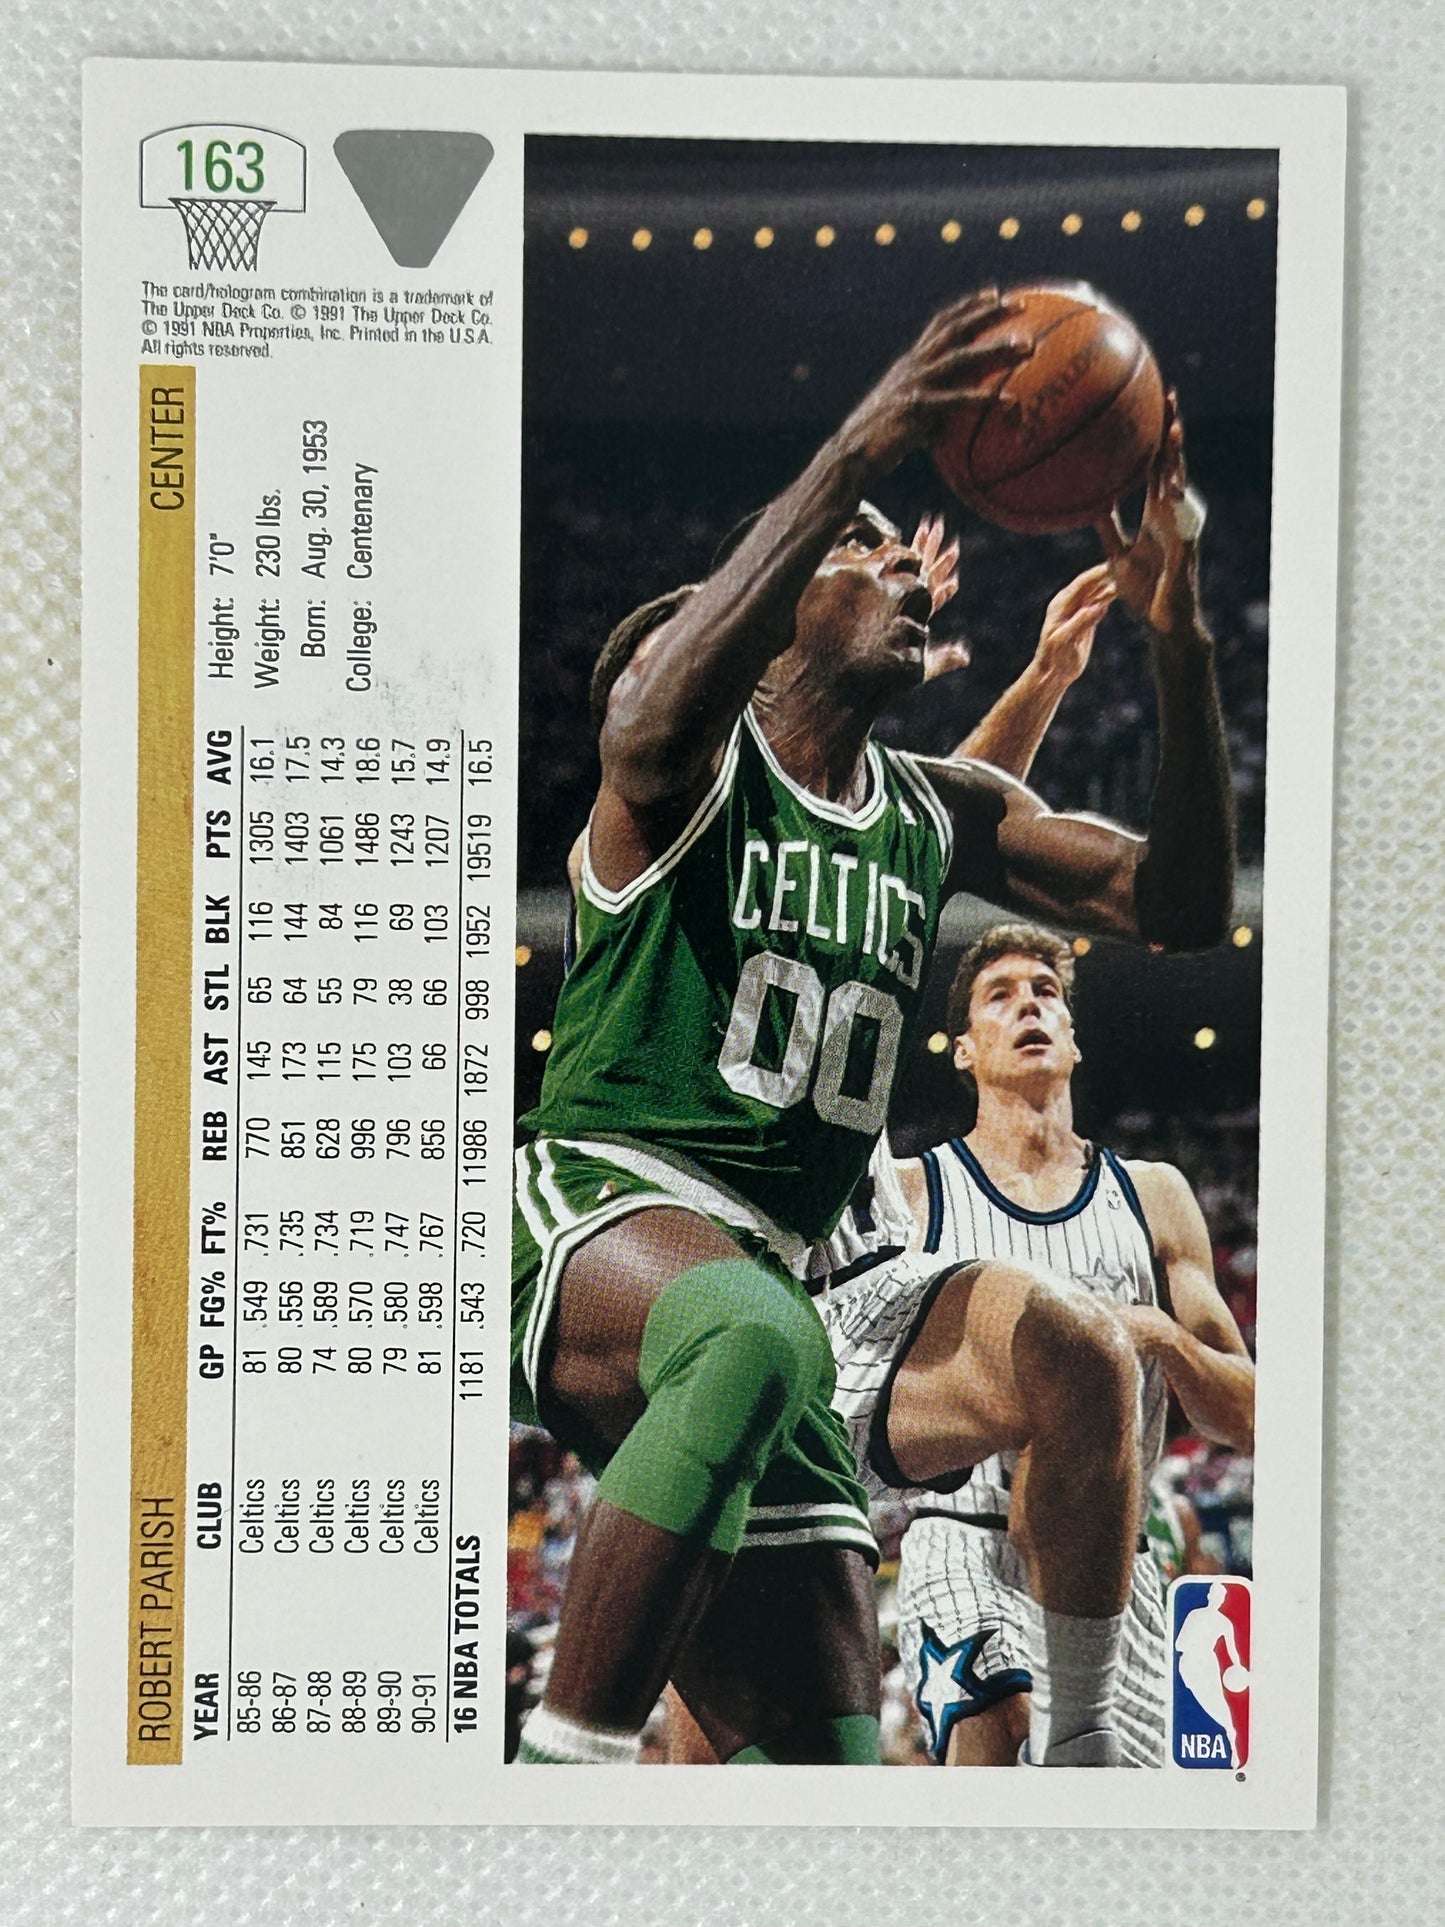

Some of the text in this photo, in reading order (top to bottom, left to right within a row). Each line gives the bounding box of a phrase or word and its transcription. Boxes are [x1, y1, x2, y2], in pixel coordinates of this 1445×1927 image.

[177, 139, 265, 193] 163
[141, 302, 168, 318] The
[173, 302, 215, 324] Upper
[222, 304, 255, 319] Deck
[262, 305, 284, 320] Co.
[313, 305, 344, 321] 1991
[352, 306, 378, 321] The
[384, 307, 425, 329] Upper
[432, 309, 465, 324] Deck
[471, 309, 493, 325] Co.
[141, 342, 273, 359] All rights reserved.
[142, 282, 168, 298] The
[281, 286, 366, 303] combination
[373, 288, 384, 303] is
[390, 293, 398, 304] a
[404, 290, 474, 305] trademark
[480, 290, 493, 306] of
[164, 321, 195, 337] 1991
[203, 322, 234, 338] NBA
[240, 323, 314, 341] Properties,
[320, 325, 344, 341] Inc.
[350, 326, 399, 342] Printed
[404, 327, 417, 343] in
[422, 328, 444, 343] the
[150, 387, 184, 510] CENTER
[301, 420, 332, 658] Born: Aug. 30, 1953
[208, 597, 239, 679] Height:
[254, 489, 285, 688] Weight: 230 lbs.
[346, 463, 378, 692] College: Centenary
[718, 950, 904, 1136] 00
[193, 730, 232, 1741] YEAR CLUB GP FG% FT% REB AST STL BLK PTS AVG
[237, 740, 274, 1733] 85-86 Celtics 81 .549 .731 770 145 65 116 1305 16.1
[272, 736, 310, 1733] 86-87 Celtics 80 .556 .735 851 173 64 144 1403 17.5
[306, 738, 345, 1733] 87-88 Celtics 74 .589 .734 628 115 55 84 1061 14.3
[342, 738, 380, 1733] 88-89 Celtics 80 .570 .719 996 175 79 116 1486 18.6
[377, 739, 415, 1733] 89-90 Celtics 79 .580 .747 796 103 38 69 1243 15.7
[412, 739, 450, 1733] 90-91 Celtics 81 .598 .767 856 66 66 103 1207 14.9
[454, 740, 492, 1733] 16 NBA TOTALS 1181 .543 .720 11986 1872 998 1952 19519 16.5
[138, 1497, 174, 1742] ROBERT PARISH
[1181, 1734, 1227, 1759] NBA
